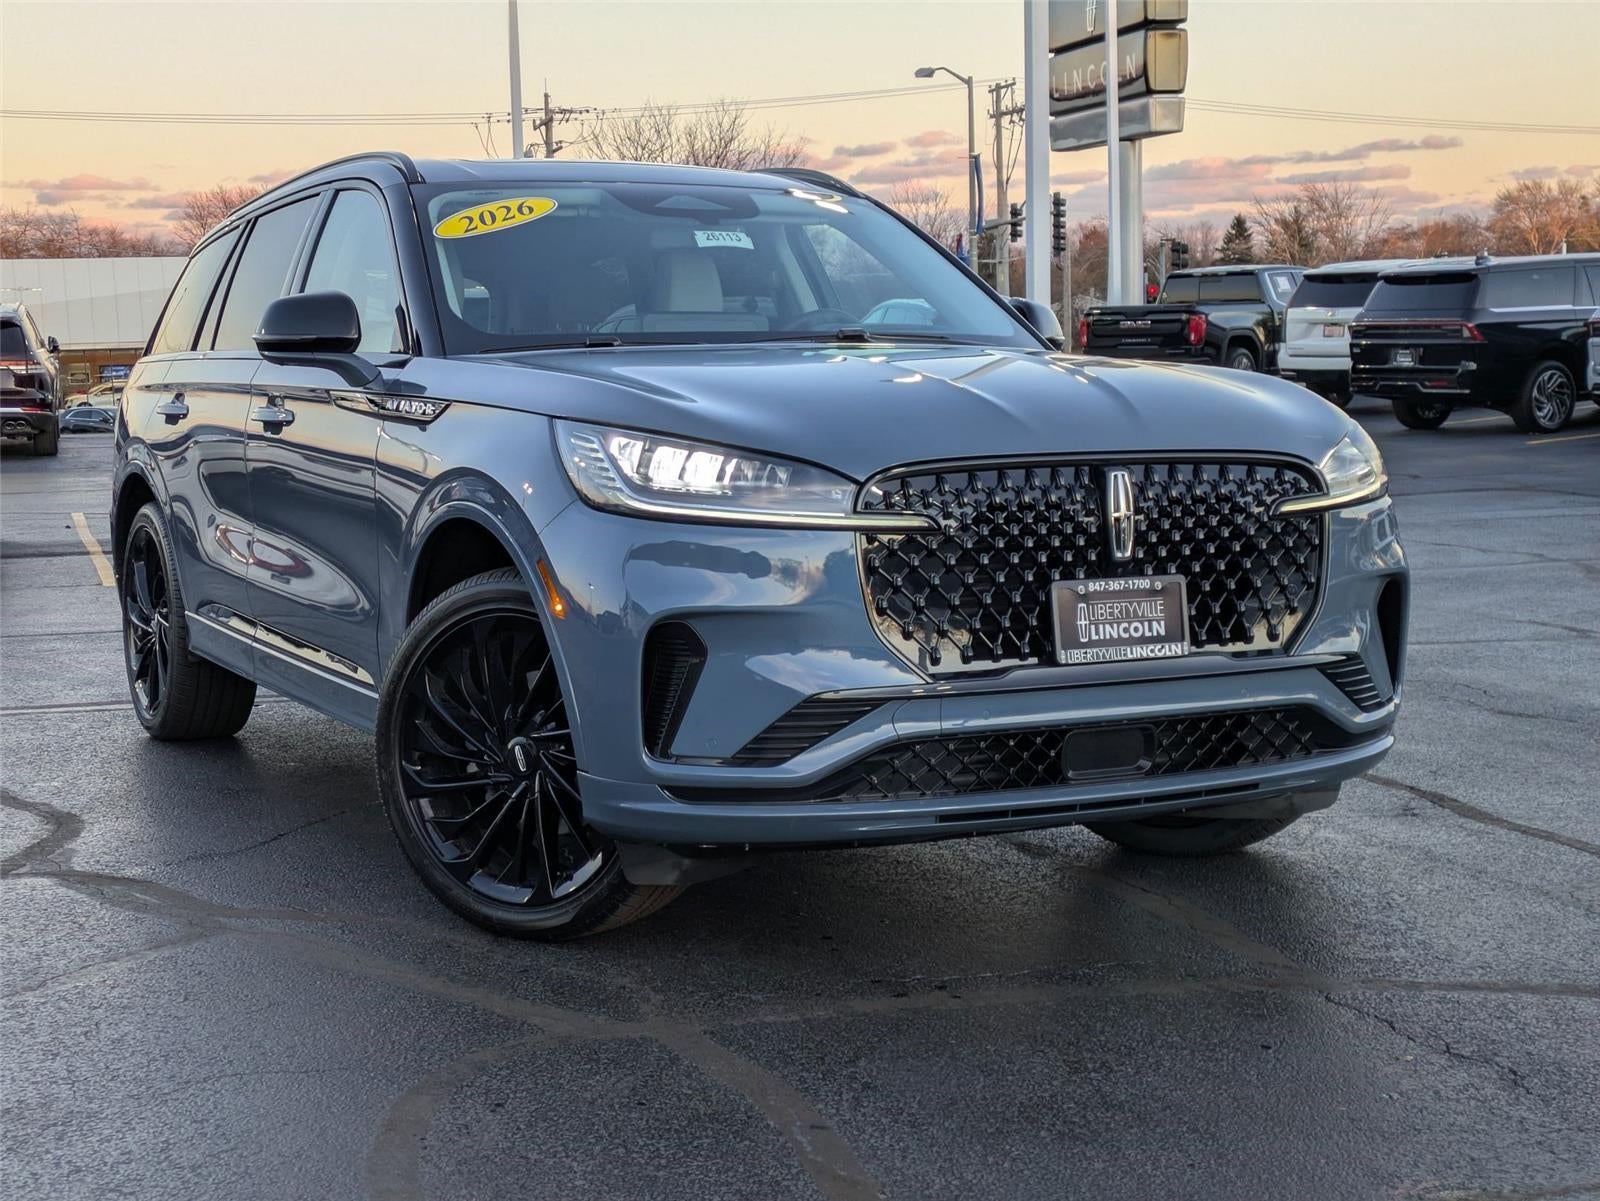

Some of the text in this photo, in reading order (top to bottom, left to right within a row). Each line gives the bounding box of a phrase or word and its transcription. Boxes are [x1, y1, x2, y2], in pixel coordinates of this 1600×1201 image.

[1052, 53, 1137, 98] LINCON
[459, 200, 535, 233] 2026
[703, 231, 742, 242] 26113
[1088, 580, 1151, 592] 847-367-1700
[1089, 600, 1165, 620] LIBERTYVILLE
[1090, 620, 1166, 641] LINCOLN
